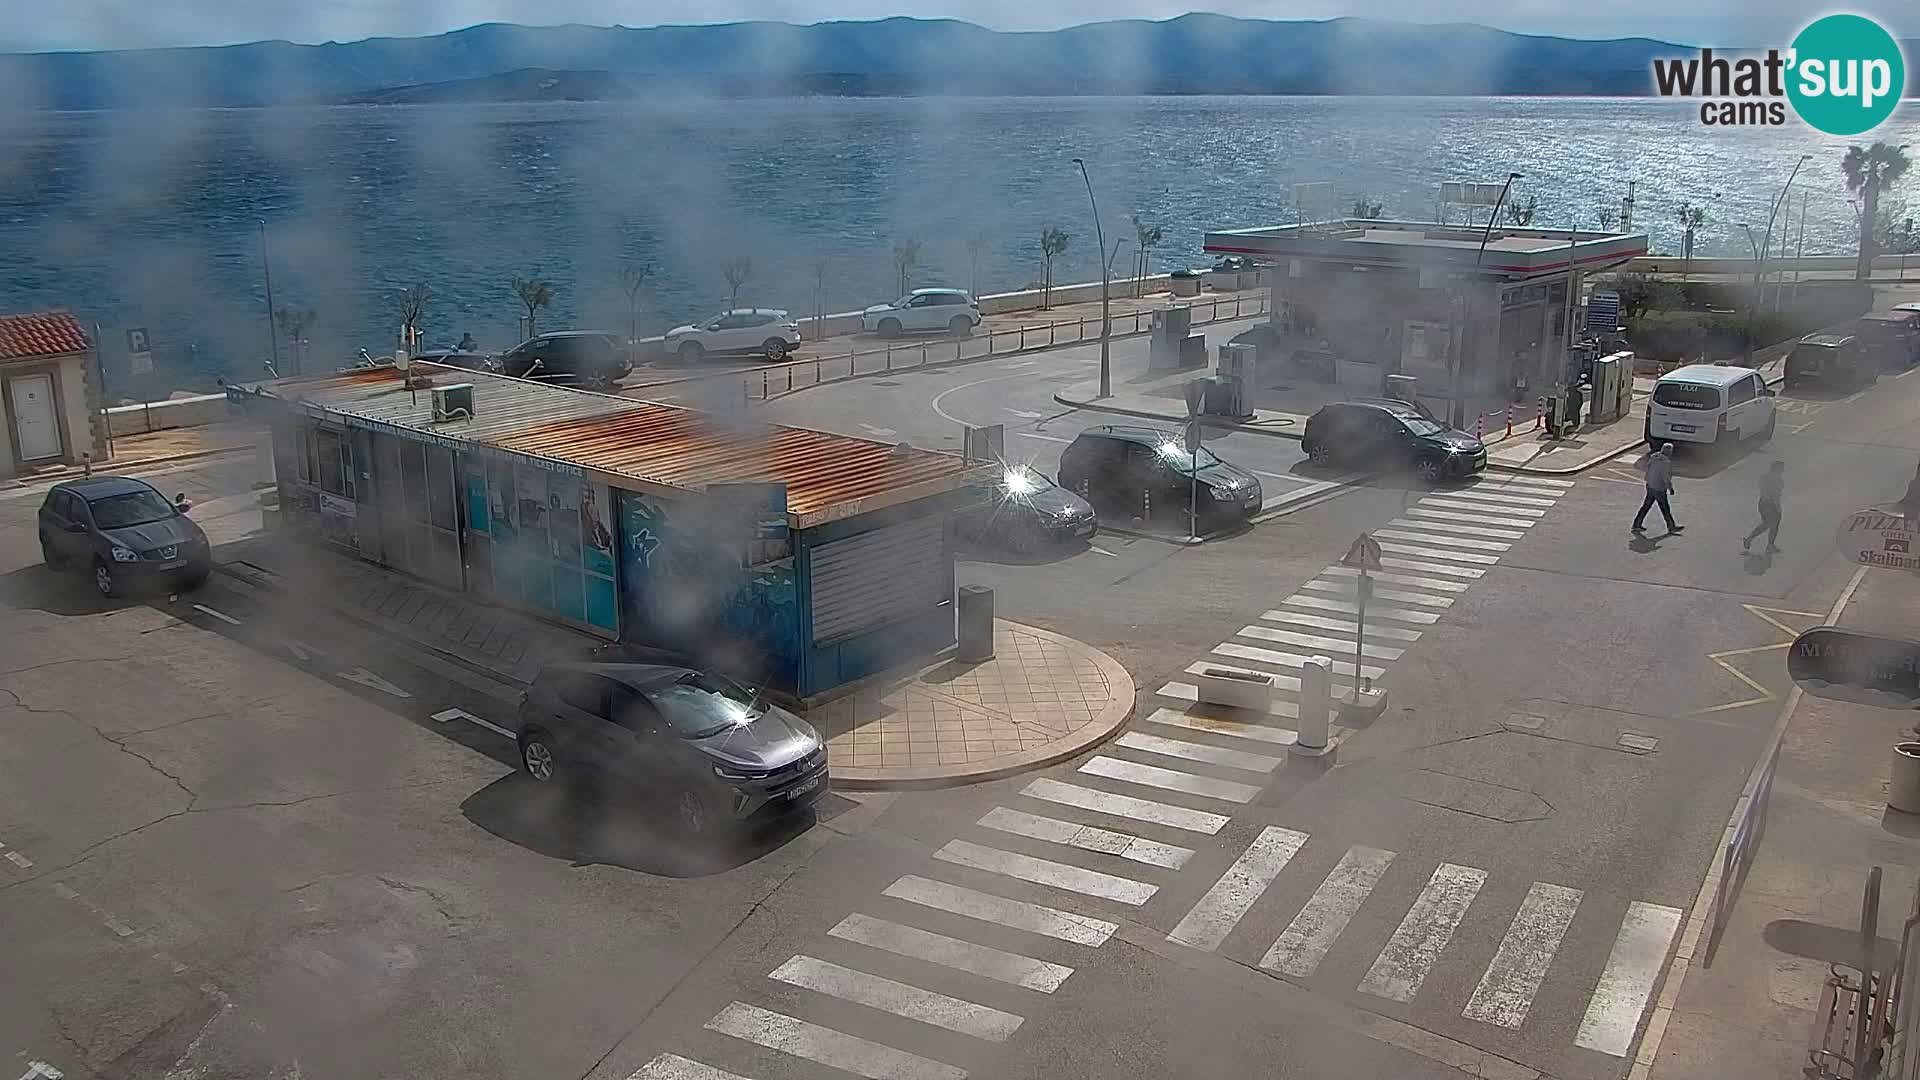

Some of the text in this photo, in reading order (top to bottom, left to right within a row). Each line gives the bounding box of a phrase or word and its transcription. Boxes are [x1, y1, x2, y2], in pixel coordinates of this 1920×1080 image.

[131, 331, 145, 352] P
[1680, 384, 1698, 392] TAXI
[530, 457, 556, 472] TICKET
[557, 464, 584, 478] OFFICE
